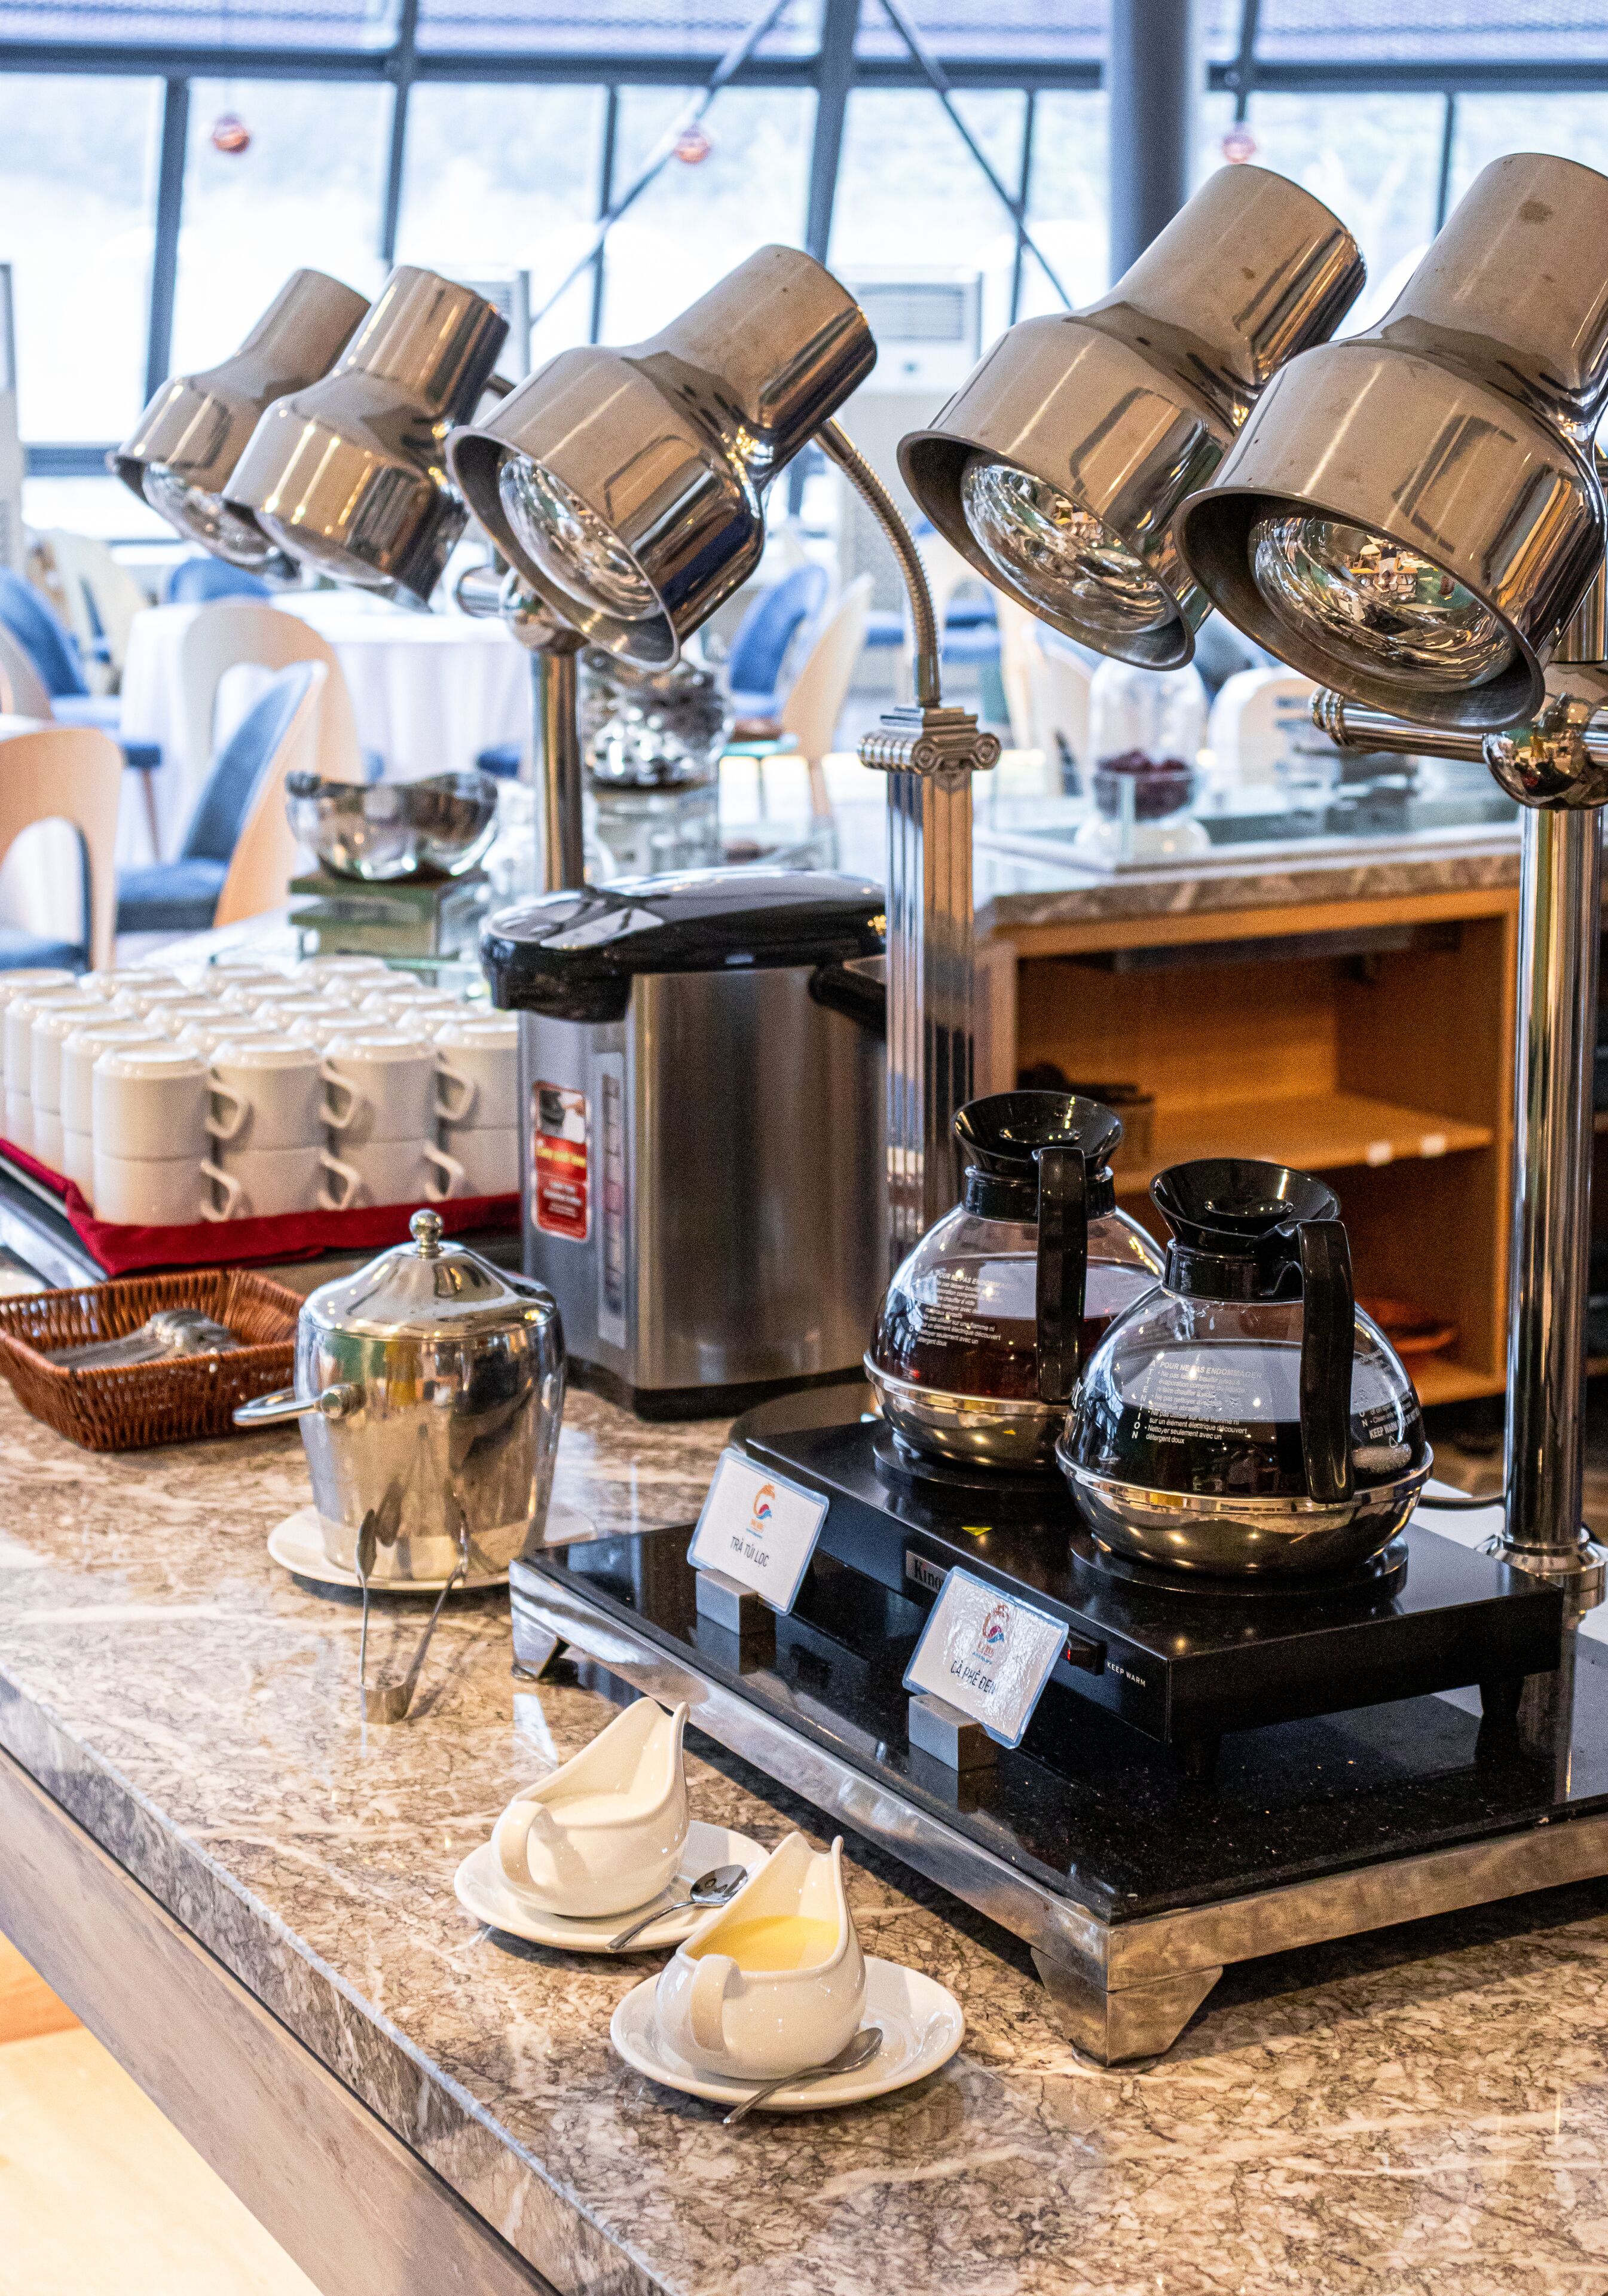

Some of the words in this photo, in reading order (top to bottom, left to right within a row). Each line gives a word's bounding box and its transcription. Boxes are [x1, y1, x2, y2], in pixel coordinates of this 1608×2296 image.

[1160, 1361, 1179, 1370] POUR
[1179, 1363, 1191, 1372] NE
[1148, 1424, 1171, 1434] Nettoyer
[1170, 1428, 1199, 1437] seulement
[1166, 1419, 1188, 1428] élément
[1188, 1421, 1216, 1431] électrique
[1216, 1424, 1248, 1435] découvert
[1368, 1425, 1384, 1440] KEEP
[1146, 1433, 1172, 1443] détergent
[1171, 1436, 1185, 1445] doux
[1107, 1661, 1124, 1675] KEEP
[1126, 1671, 1146, 1687] WARM
